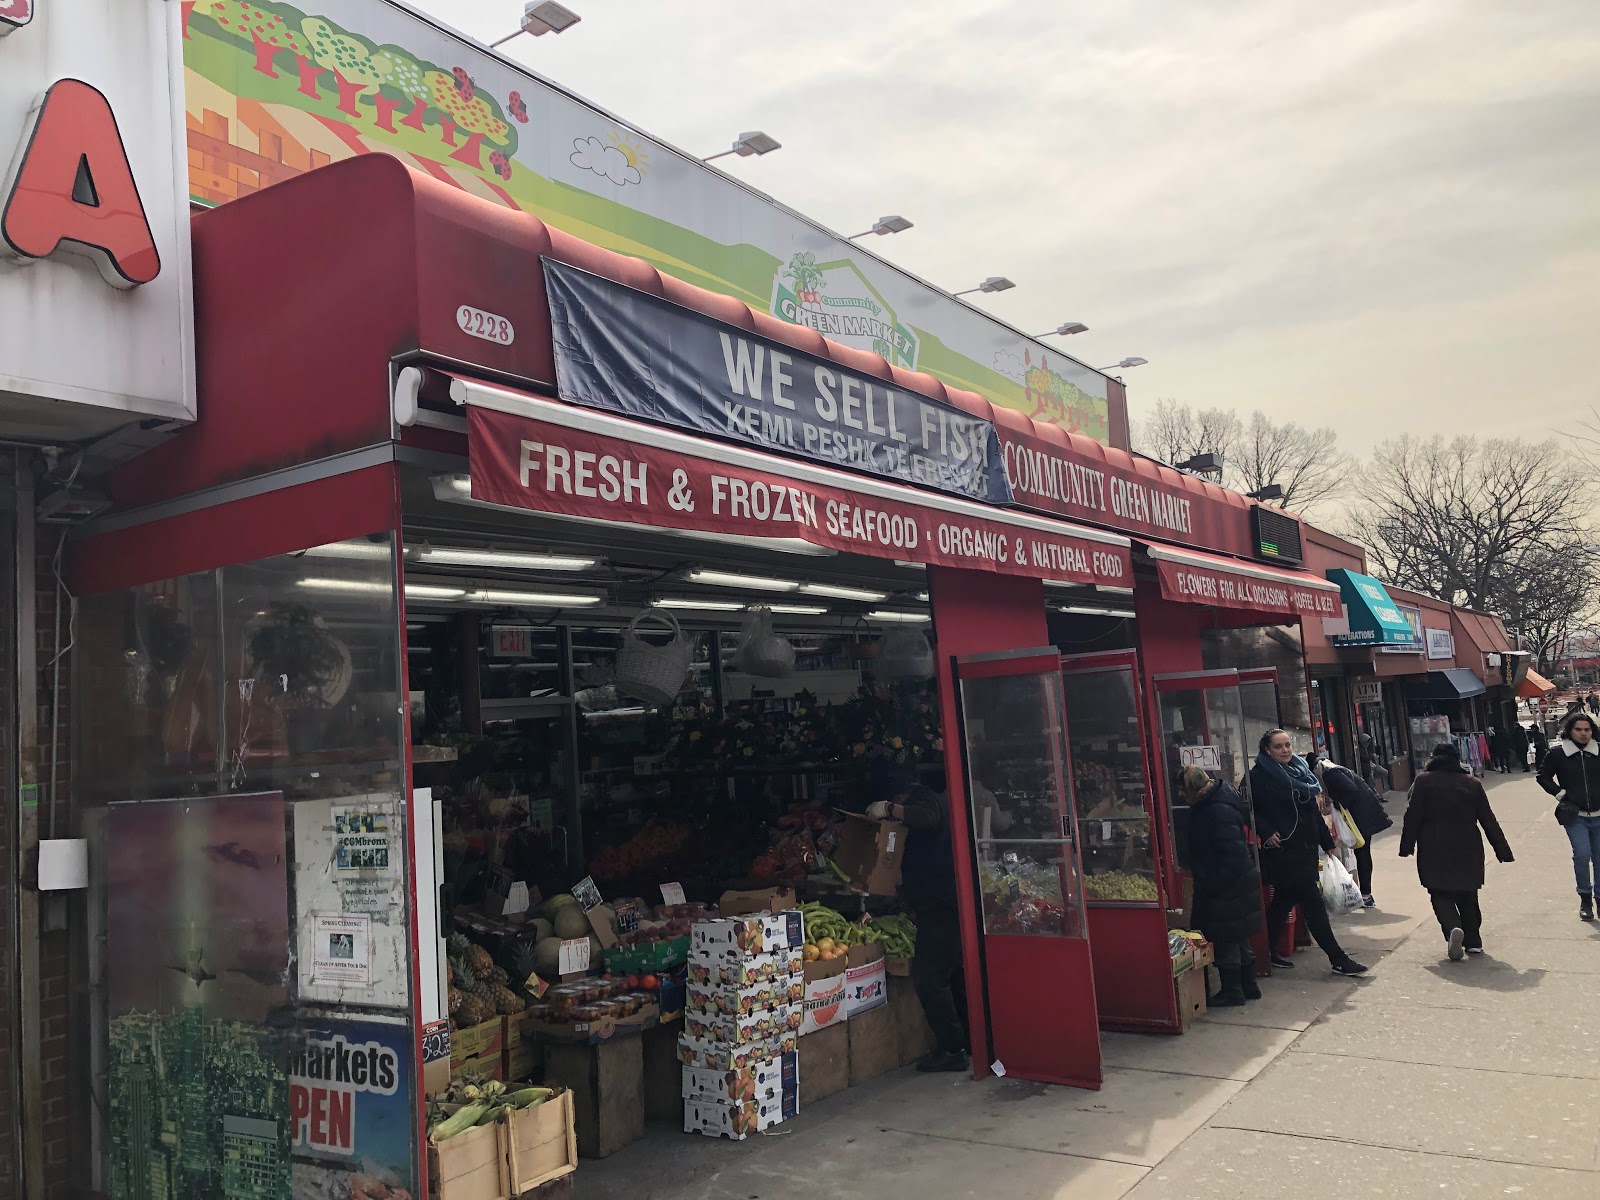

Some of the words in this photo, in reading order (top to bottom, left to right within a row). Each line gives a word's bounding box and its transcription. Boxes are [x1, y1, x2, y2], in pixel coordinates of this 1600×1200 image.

[2, 77, 161, 285] A
[462, 308, 511, 343] 2228
[780, 298, 842, 335] GREEN
[844, 315, 913, 354] MARKET
[821, 296, 881, 316] community
[719, 331, 796, 411] WE
[813, 364, 907, 444] SELL
[919, 403, 989, 468] FISH
[724, 401, 796, 449] KEMI
[802, 419, 879, 468] PESHK
[519, 439, 649, 506] FRESH
[667, 468, 695, 513] &
[710, 474, 818, 529] FROZEN
[825, 499, 919, 549] SEAFOOD
[937, 523, 1008, 563] ORGANIC
[1014, 537, 1028, 566] &
[1031, 540, 1091, 575] NATURAL
[1092, 551, 1123, 578] FOOD
[1004, 440, 1107, 513] COMMUNITY
[1109, 475, 1151, 525] GREEN
[1150, 489, 1193, 535] MARKET
[1177, 572, 1218, 599] FLOWERS
[1219, 579, 1236, 601] FOR
[1237, 583, 1253, 602] ALL
[1252, 584, 1289, 608] OCCASIONS
[1293, 593, 1315, 611] COFFEE
[1356, 683, 1379, 696] ATM
[1182, 746, 1220, 767] OPEN
[426, 1025, 439, 1034] CORN
